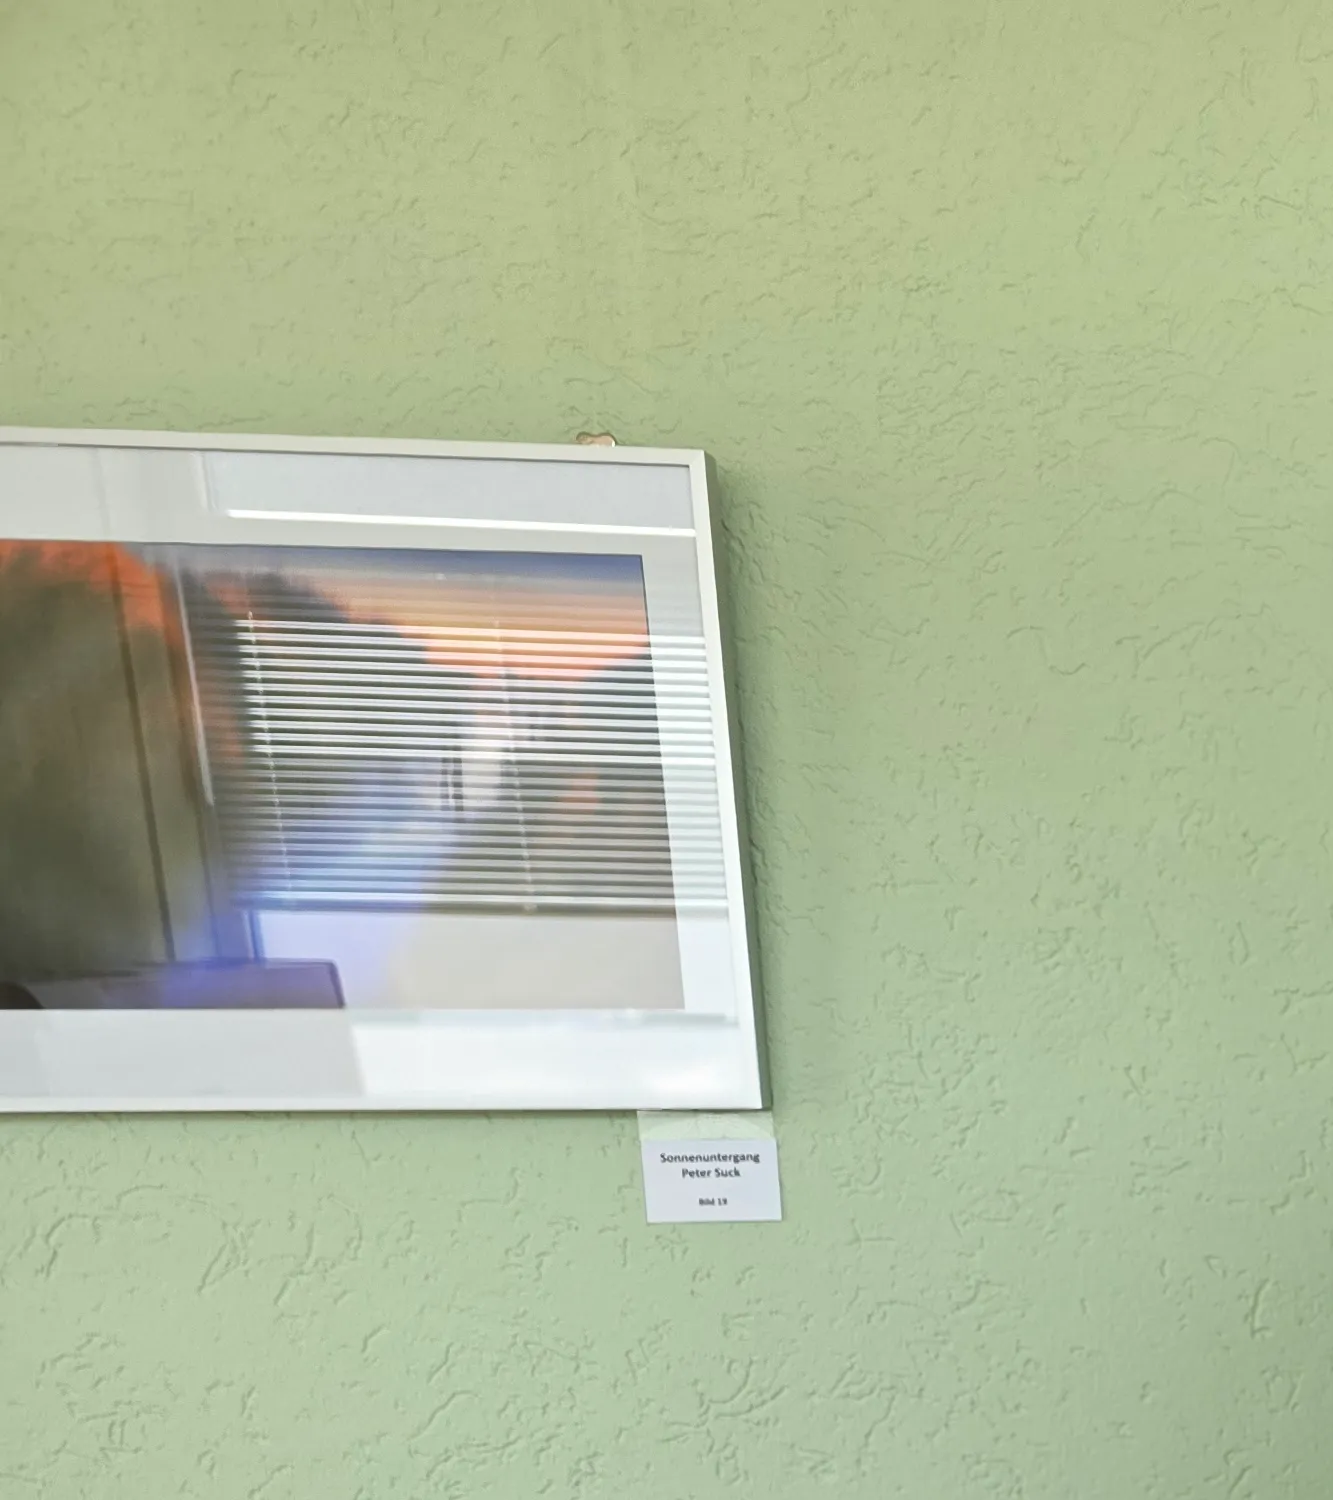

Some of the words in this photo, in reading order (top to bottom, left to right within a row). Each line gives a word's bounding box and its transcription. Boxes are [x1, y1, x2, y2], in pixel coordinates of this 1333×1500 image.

[660, 1153, 760, 1163] Sonnenuntergang
[682, 1168, 711, 1178] Peter
[715, 1167, 741, 1177] Suck
